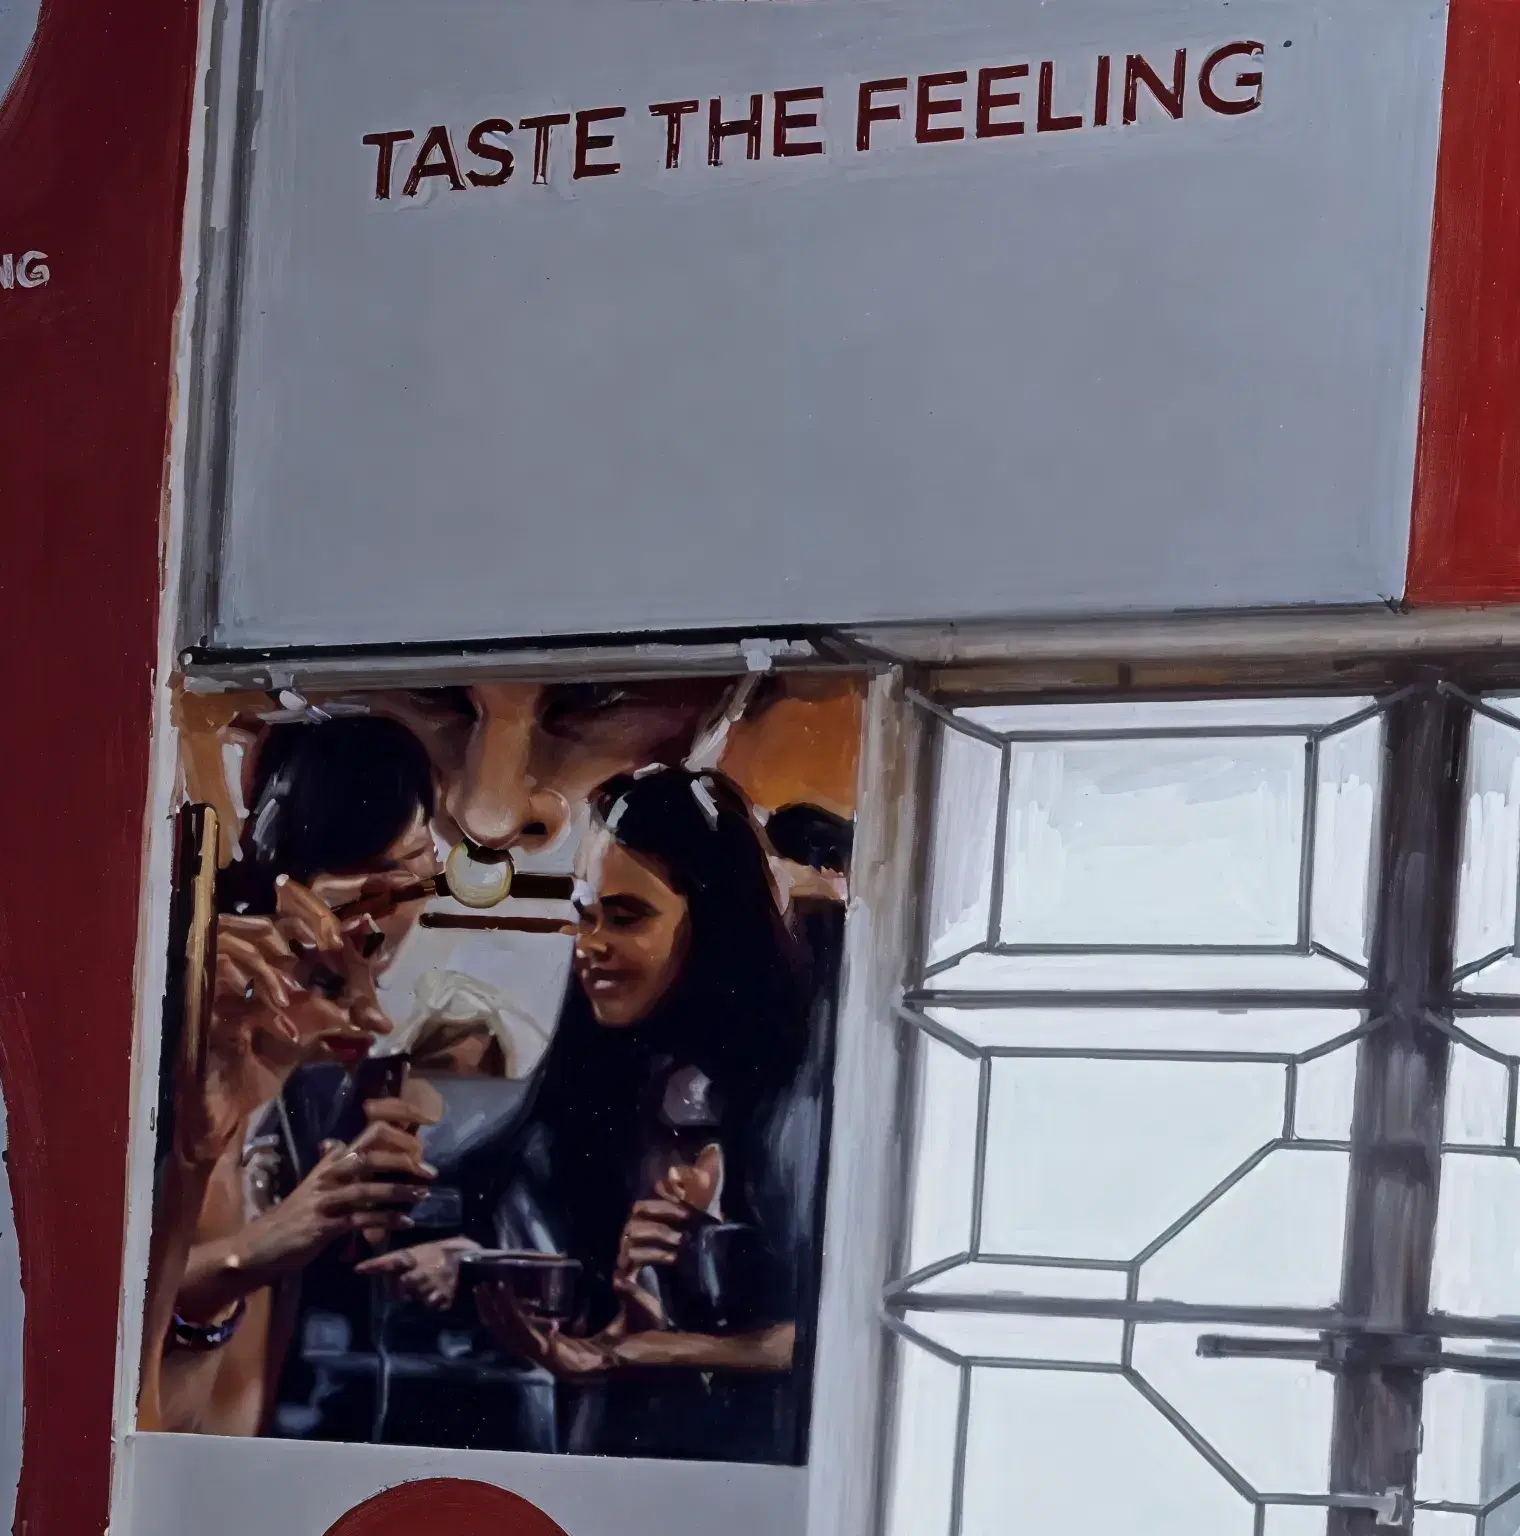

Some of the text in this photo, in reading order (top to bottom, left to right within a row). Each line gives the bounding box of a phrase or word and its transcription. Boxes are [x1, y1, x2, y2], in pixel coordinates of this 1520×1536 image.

[362, 40, 1266, 200] TASTE THE FEELING
